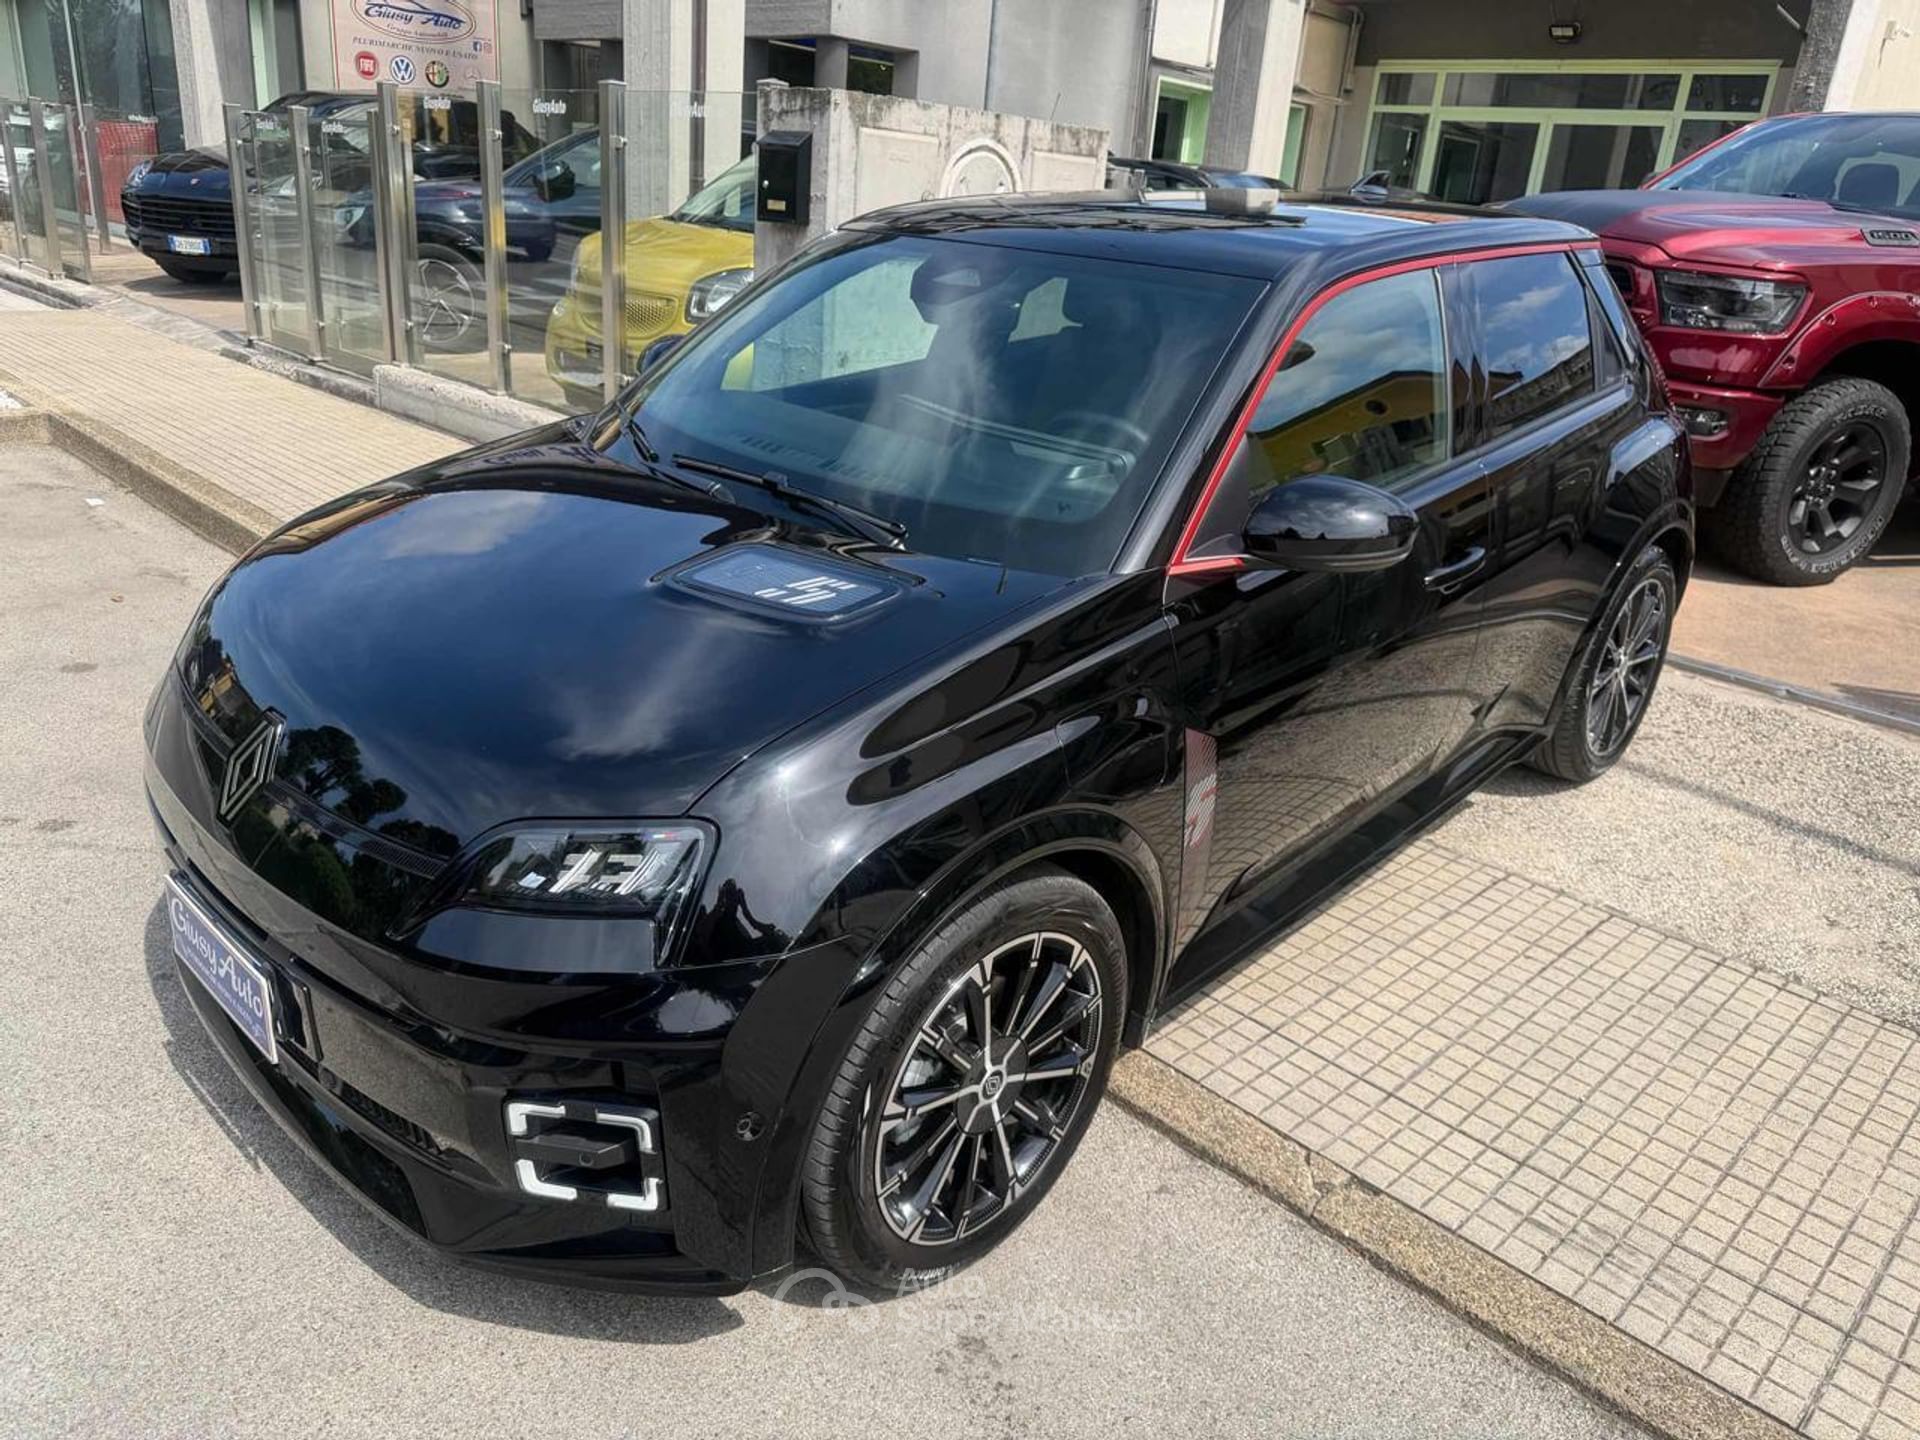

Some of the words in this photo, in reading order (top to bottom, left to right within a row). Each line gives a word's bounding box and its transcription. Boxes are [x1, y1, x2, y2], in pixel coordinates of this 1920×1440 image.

[364, 5, 413, 25] Giusy
[420, 13, 463, 30] Auto
[1869, 229, 1913, 240] 1500
